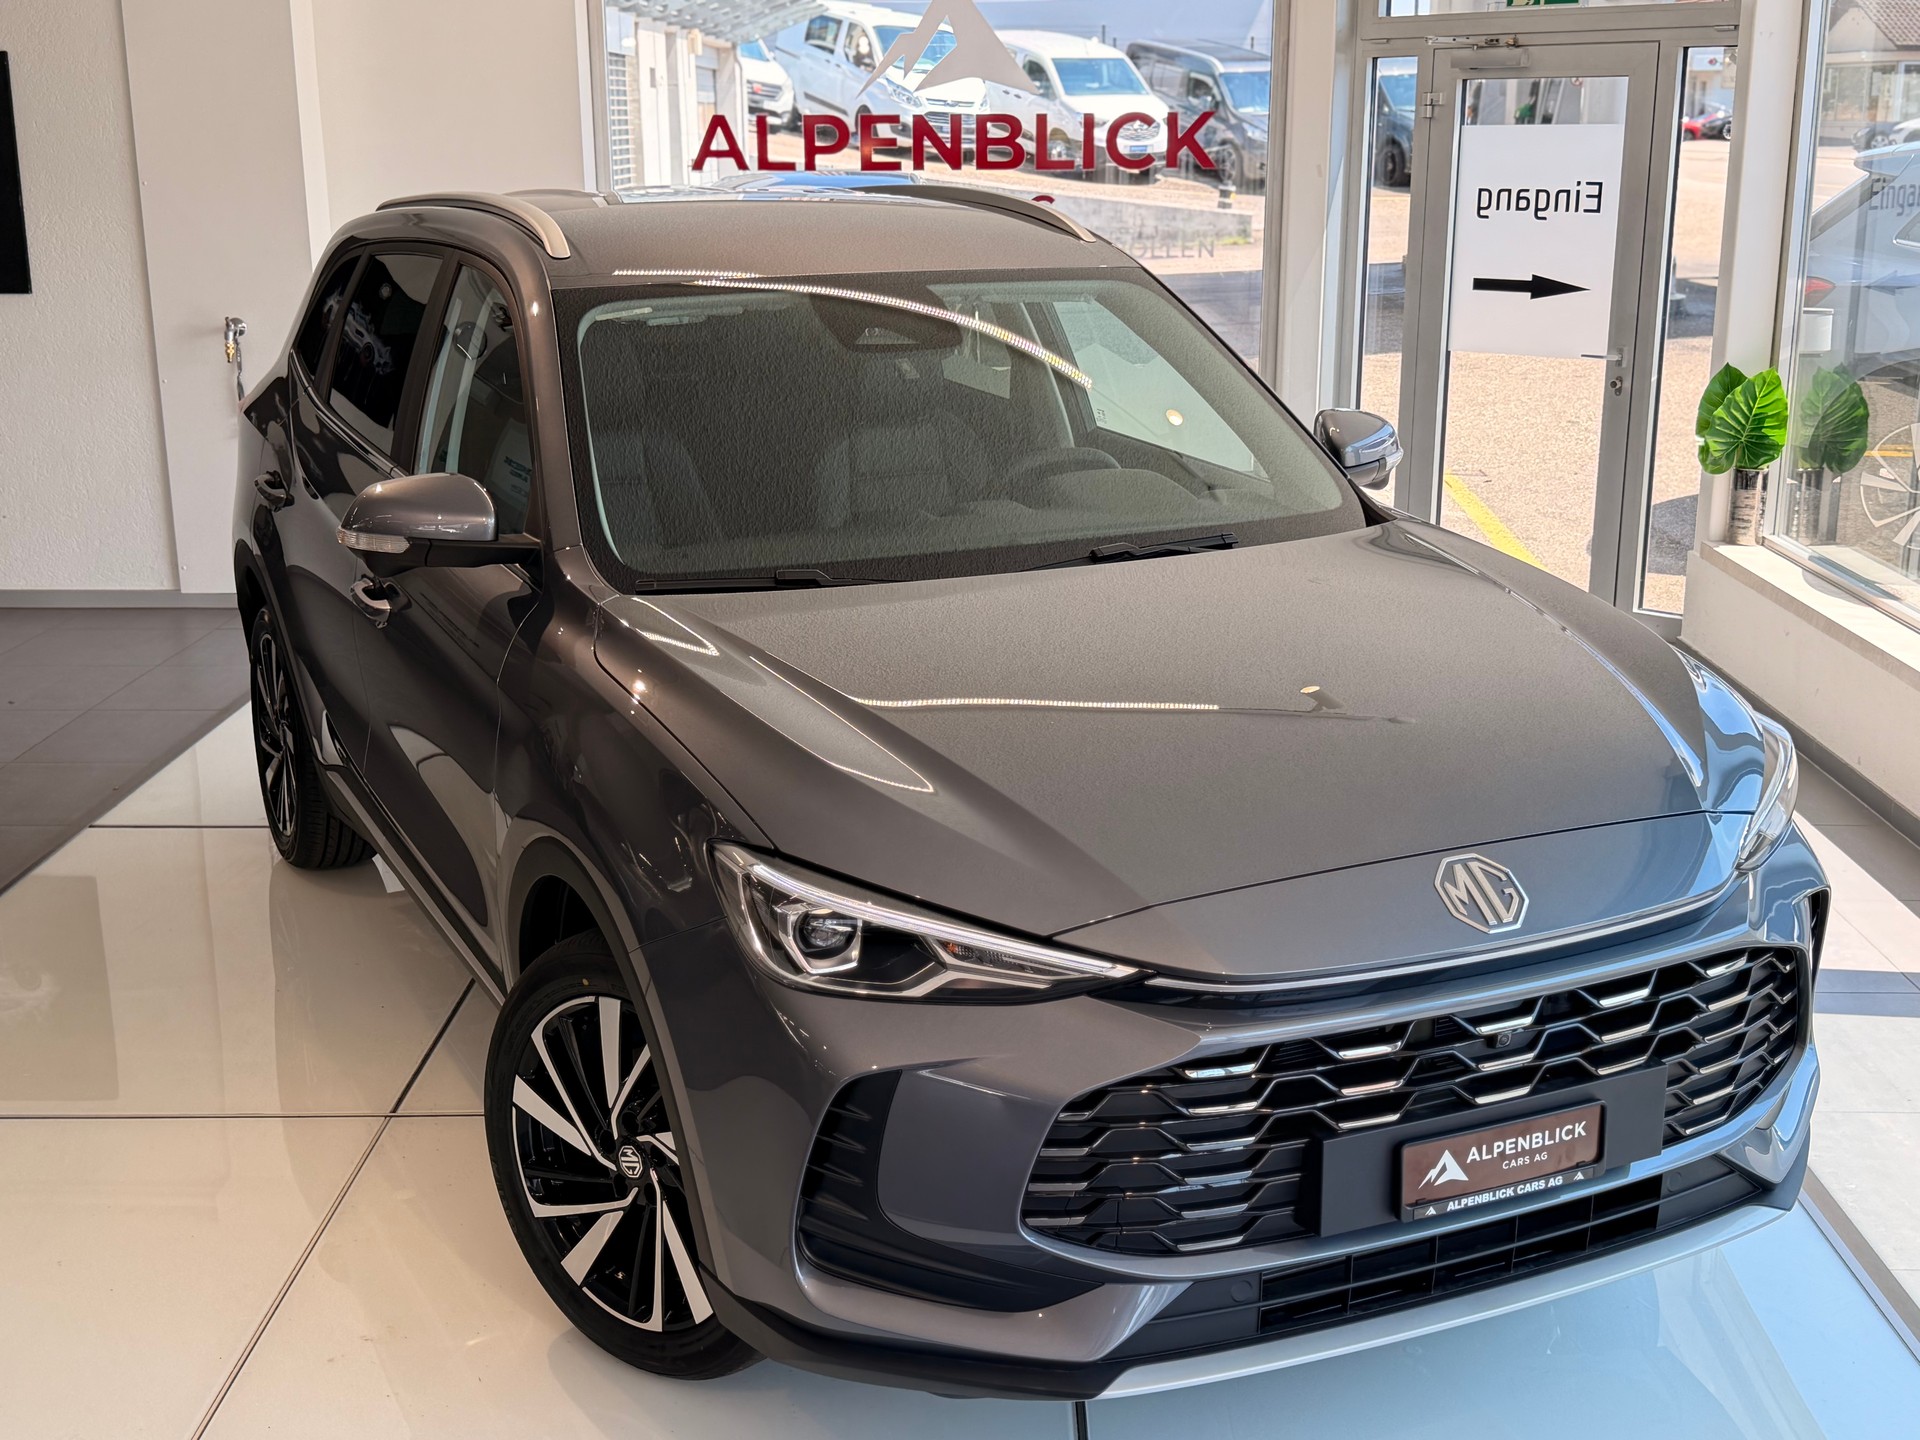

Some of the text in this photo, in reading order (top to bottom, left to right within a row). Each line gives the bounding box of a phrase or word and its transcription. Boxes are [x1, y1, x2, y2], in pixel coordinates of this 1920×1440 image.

[691, 111, 1219, 172] ALPENBLICK
[1442, 861, 1520, 926] MG
[620, 1148, 640, 1175] MG
[1466, 1120, 1587, 1164] ALPENBLICK
[1502, 1151, 1548, 1170] CARS AG
[1446, 1175, 1563, 1212] ALPENBLICK CARS AG
